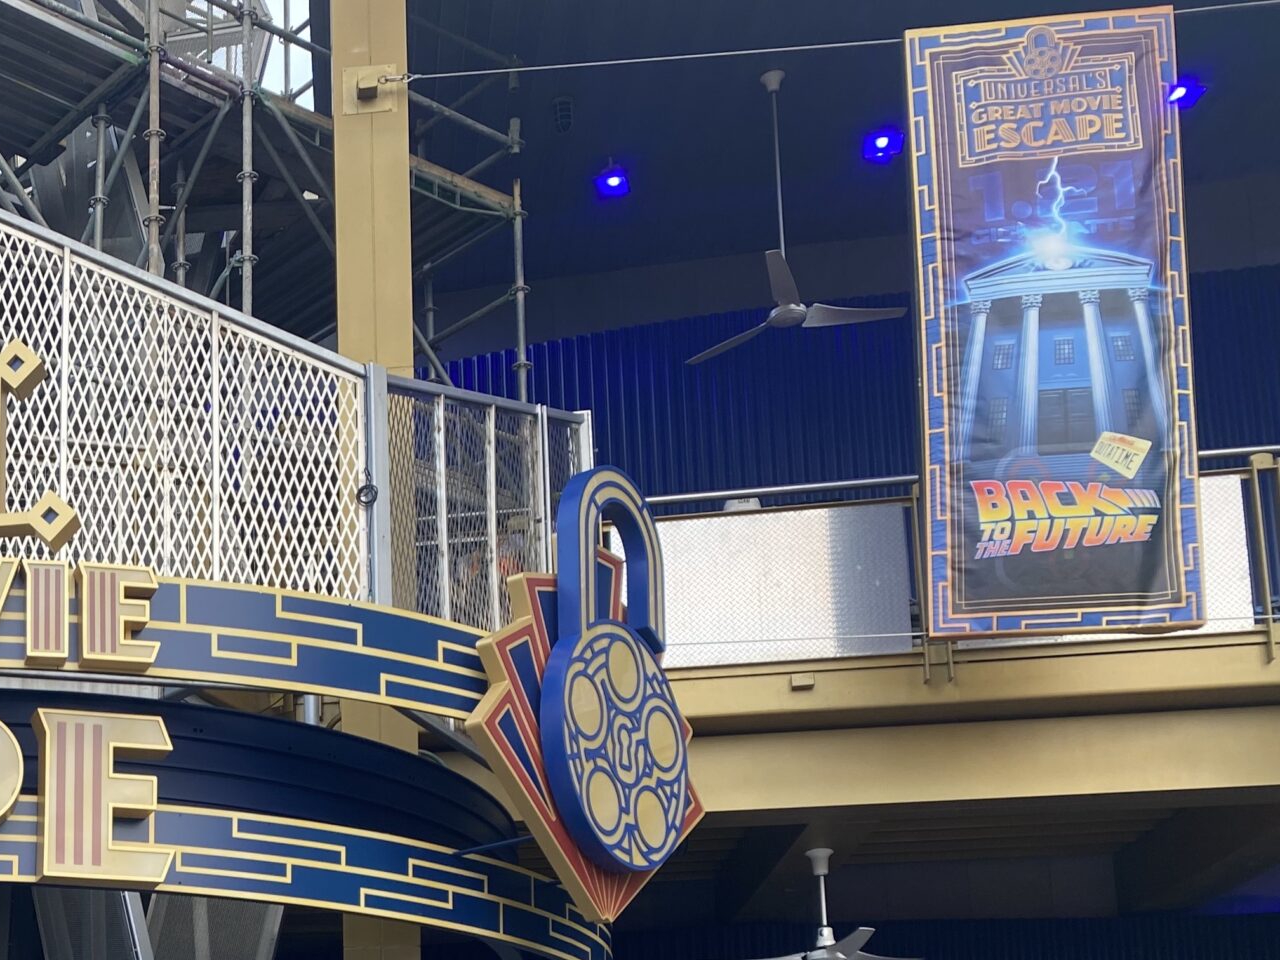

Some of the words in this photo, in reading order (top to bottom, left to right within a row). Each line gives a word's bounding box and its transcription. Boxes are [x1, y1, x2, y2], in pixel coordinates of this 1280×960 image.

[984, 70, 1107, 100] UNIVERSAL'S
[971, 102, 1045, 124] GREAT
[1050, 94, 1124, 116] MOVIE
[973, 113, 1126, 152] ESCAPE
[970, 479, 1156, 522] BACK
[974, 540, 1011, 560] THE
[1008, 514, 1159, 554] FUTURE
[979, 521, 1011, 541] TO
